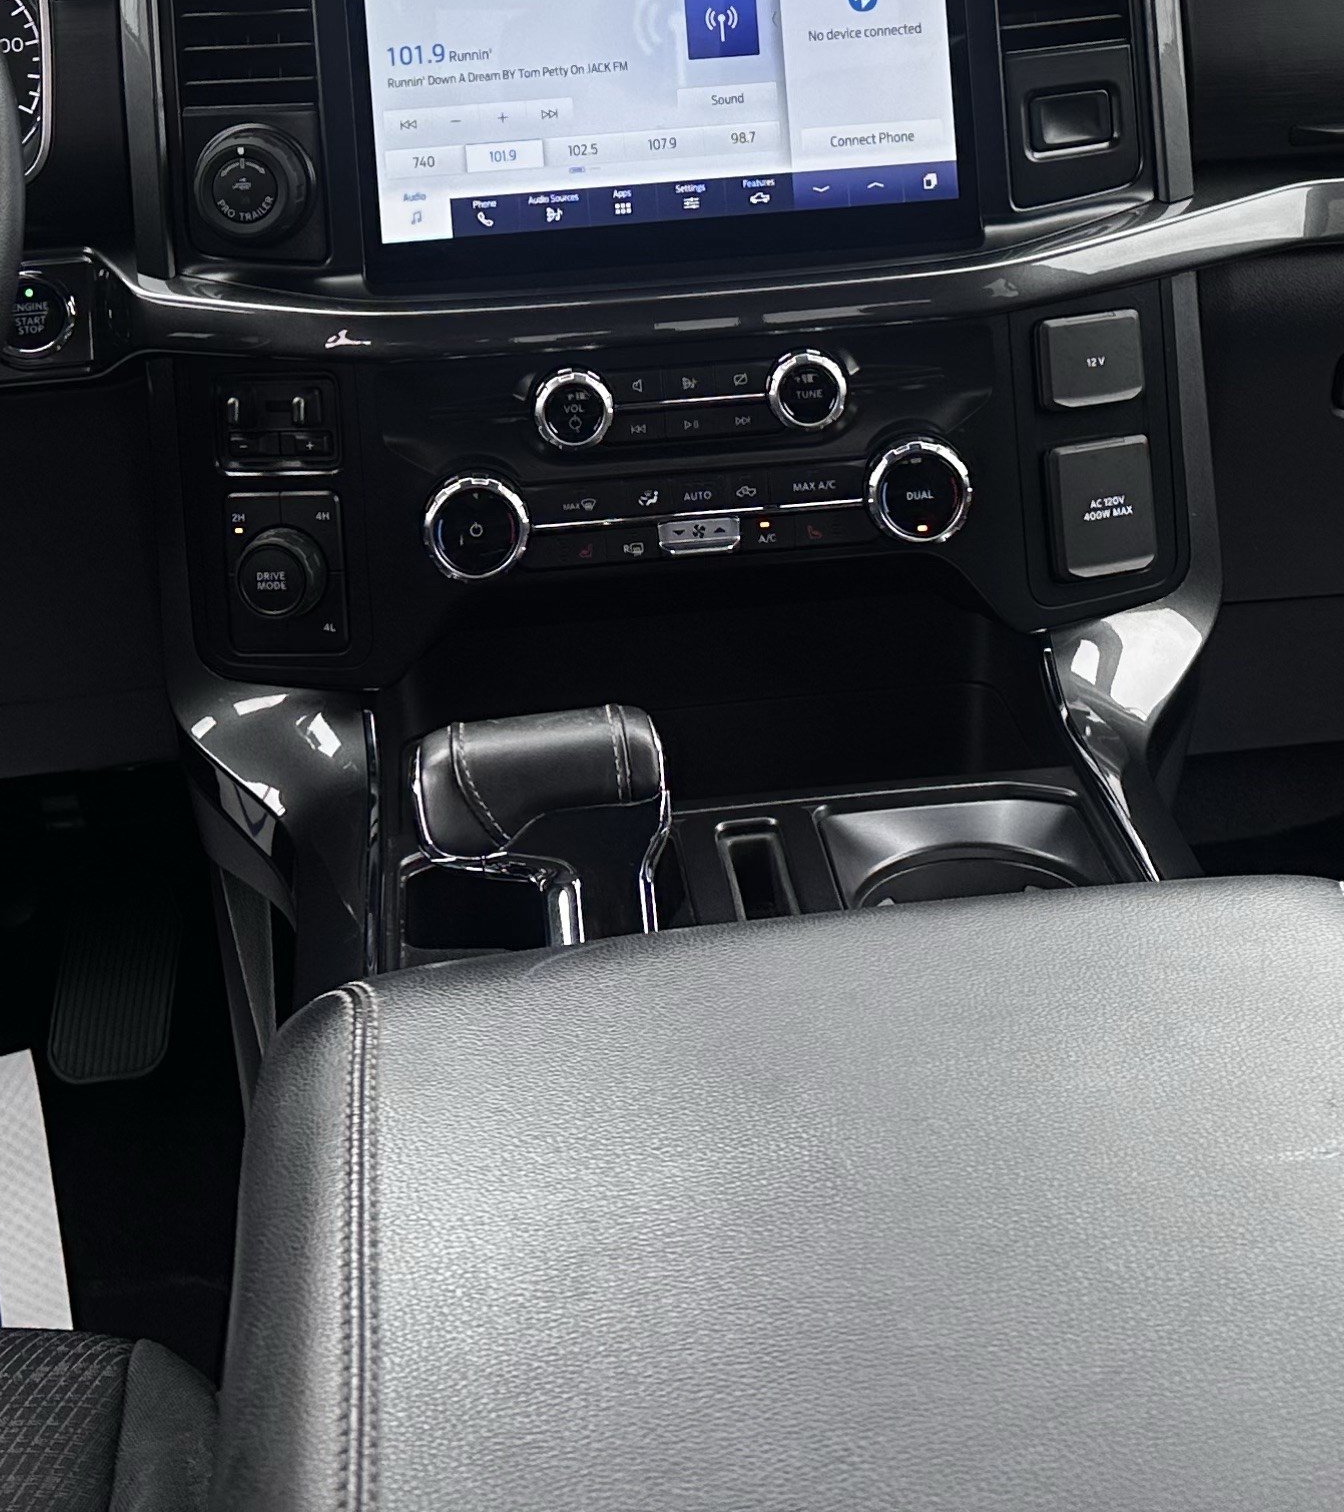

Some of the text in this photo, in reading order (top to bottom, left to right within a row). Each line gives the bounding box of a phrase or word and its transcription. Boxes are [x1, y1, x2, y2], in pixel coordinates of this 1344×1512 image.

[808, 23, 923, 42] No device connected
[387, 43, 493, 67] 101.9 Runnin'
[387, 61, 629, 89] Runnin' Down A Dream BY Tom Petty On JACK FM
[711, 93, 745, 106] Sound
[830, 131, 915, 148] Connect Phone
[412, 132, 756, 169] 740 101.9 102.5 107.9 98.7
[403, 178, 775, 209] Audio Phone Audio Sources Apps Settings Features
[216, 195, 275, 222] PRO TRAILER
[15, 315, 46, 326] START
[17, 324, 45, 336] STOP
[796, 388, 824, 399] TUNE
[563, 404, 584, 414] VOL
[792, 479, 837, 493] MAX A/C
[683, 490, 712, 501] AUTO
[906, 490, 935, 501] DUAL
[1089, 495, 1126, 509] AC 120V
[231, 512, 246, 523] 2H
[315, 511, 330, 521] 4H
[1083, 506, 1134, 522] 400W MAX
[757, 532, 776, 543] A/C
[256, 571, 286, 581] DRIVE
[256, 580, 287, 590] MODE
[323, 622, 336, 632] 4L
